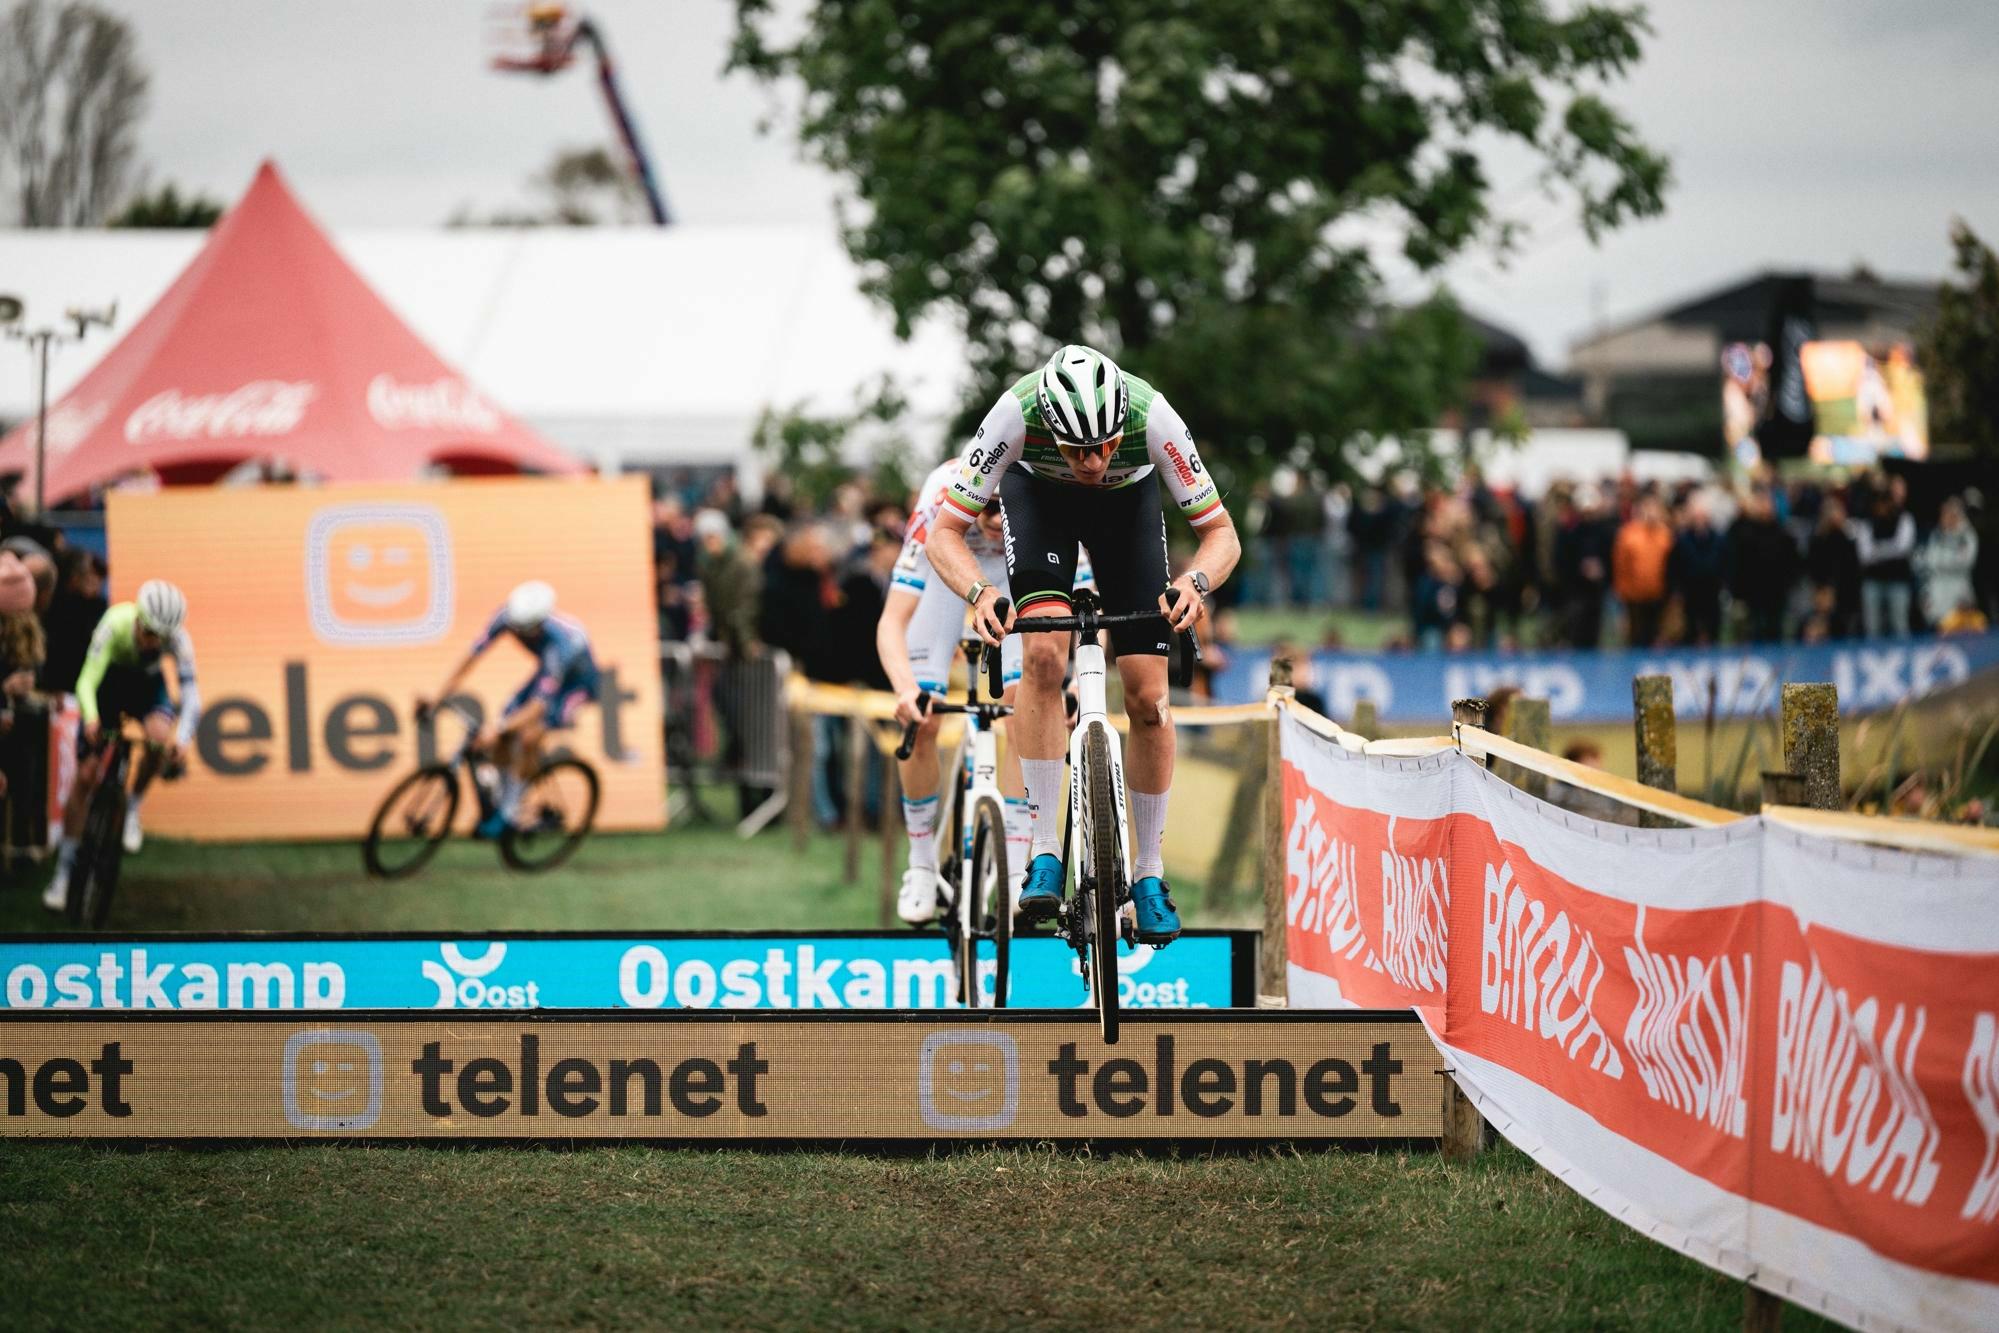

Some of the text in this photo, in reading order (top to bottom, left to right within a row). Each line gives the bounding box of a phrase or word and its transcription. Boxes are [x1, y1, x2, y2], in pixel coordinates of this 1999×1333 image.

[969, 447, 984, 468] 6
[980, 441, 1009, 475] crelan
[1163, 441, 1197, 487] corendon
[1189, 453, 1201, 474] 6
[954, 482, 967, 492] DT
[1181, 486, 1214, 508] DT SWISS
[1114, 761, 1125, 811] STEVENS
[412, 1033, 769, 1118] telenet
[1047, 1034, 1404, 1118] telenet
